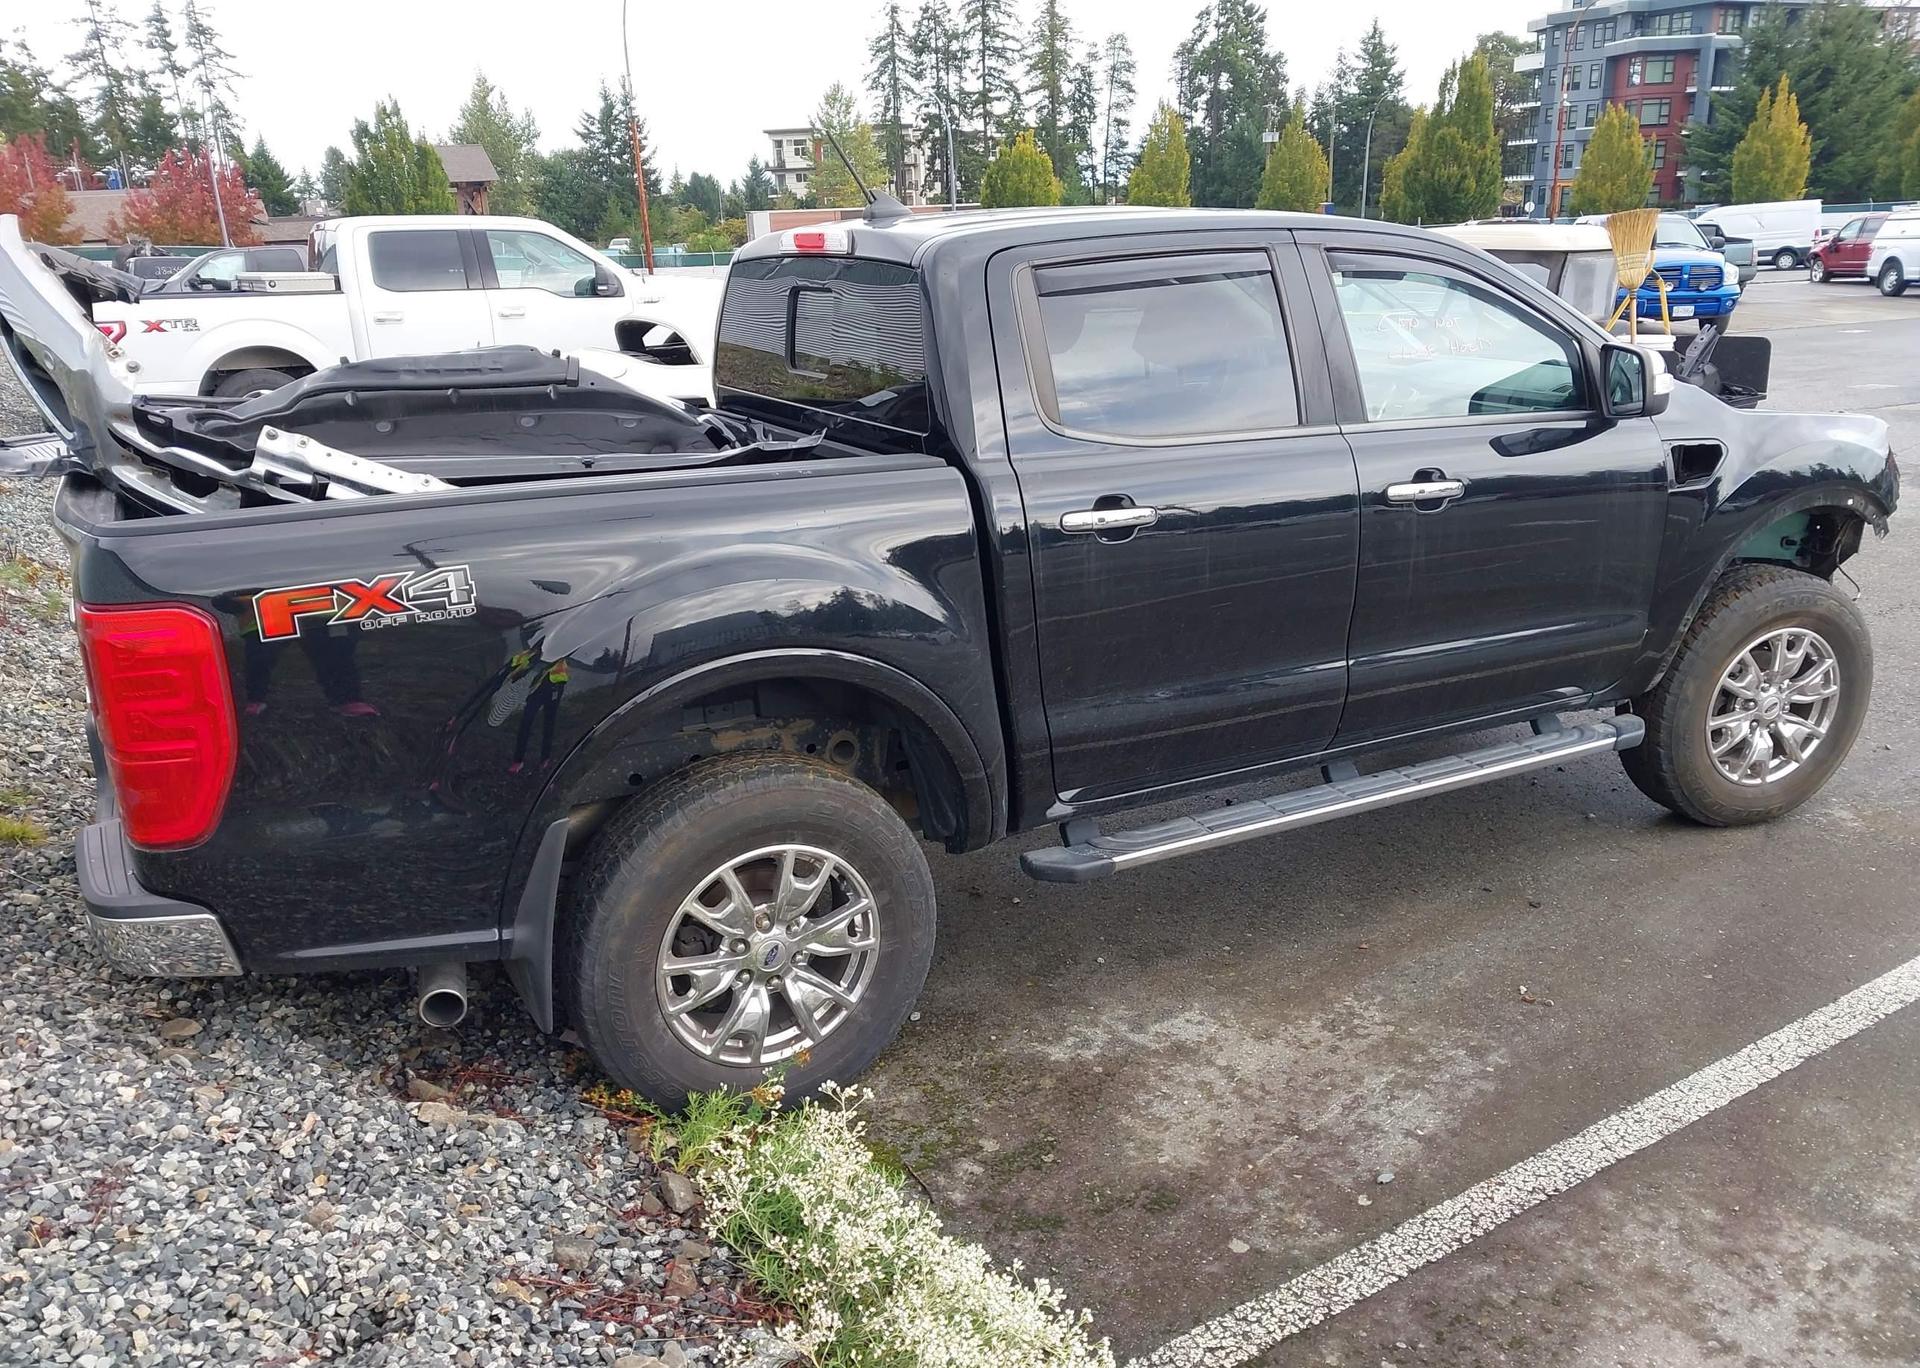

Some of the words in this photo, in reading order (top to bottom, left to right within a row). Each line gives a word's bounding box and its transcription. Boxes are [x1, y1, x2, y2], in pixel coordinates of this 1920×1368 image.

[139, 318, 199, 333] XTR
[252, 564, 477, 642] FX4
[360, 614, 408, 631] OFF
[415, 606, 477, 624] ROAD
